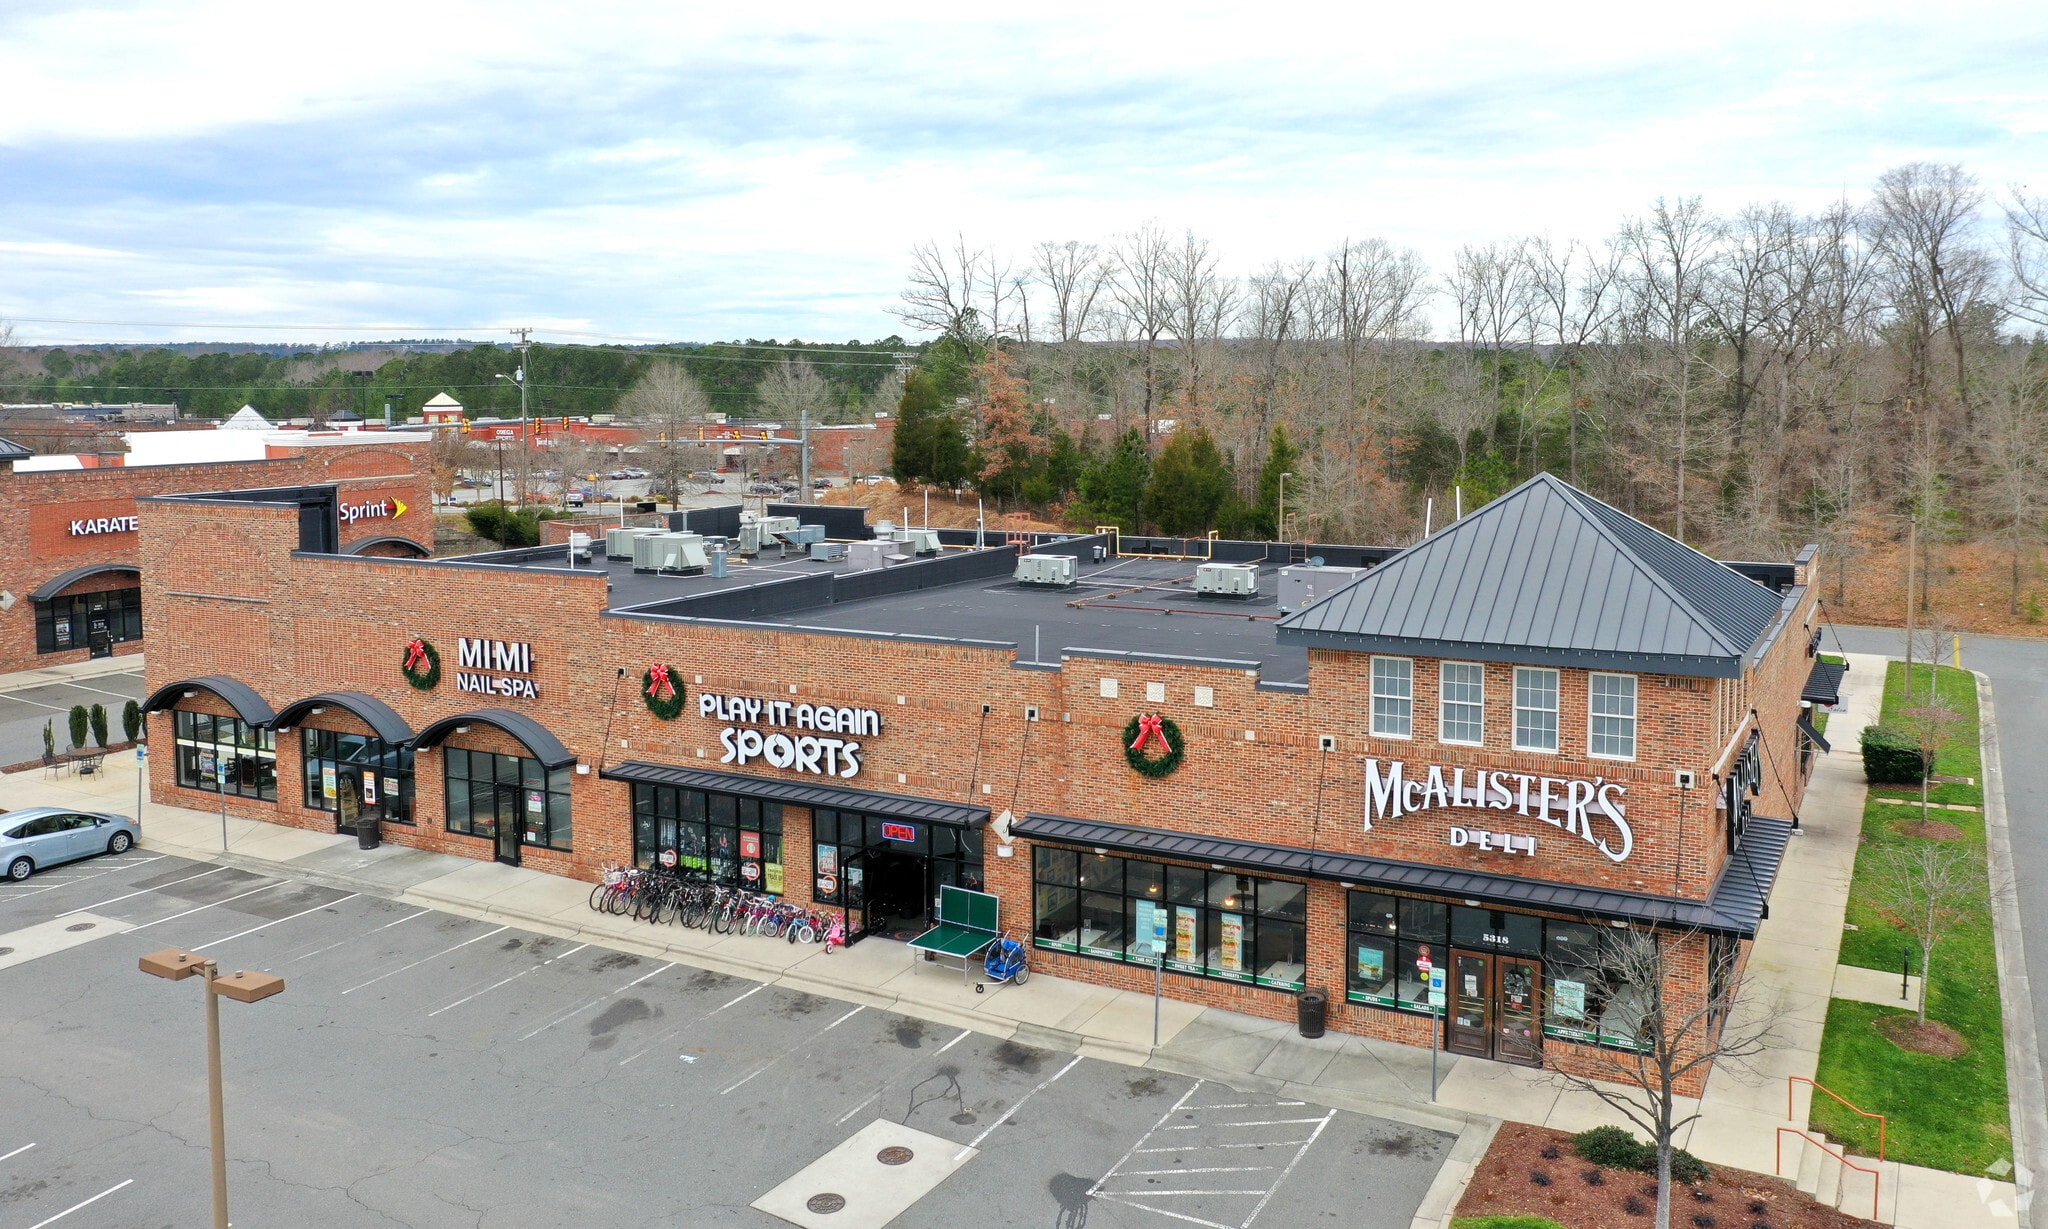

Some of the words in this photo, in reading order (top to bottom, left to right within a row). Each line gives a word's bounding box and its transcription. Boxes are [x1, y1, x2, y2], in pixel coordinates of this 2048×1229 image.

[339, 500, 388, 524] Sprint
[71, 516, 139, 536] KARATE
[457, 672, 497, 695] NAIL
[500, 677, 536, 699] SPA
[700, 693, 762, 724] PLAY
[768, 700, 792, 727] IT
[796, 703, 879, 737] AGAIN
[719, 727, 861, 778] SPORTS
[883, 823, 915, 841] OPEN
[1449, 826, 1537, 857] DELI
[1482, 933, 1509, 944] 5318
[1270, 980, 1291, 988] CATERING
[1413, 1003, 1430, 1011] SALADS
